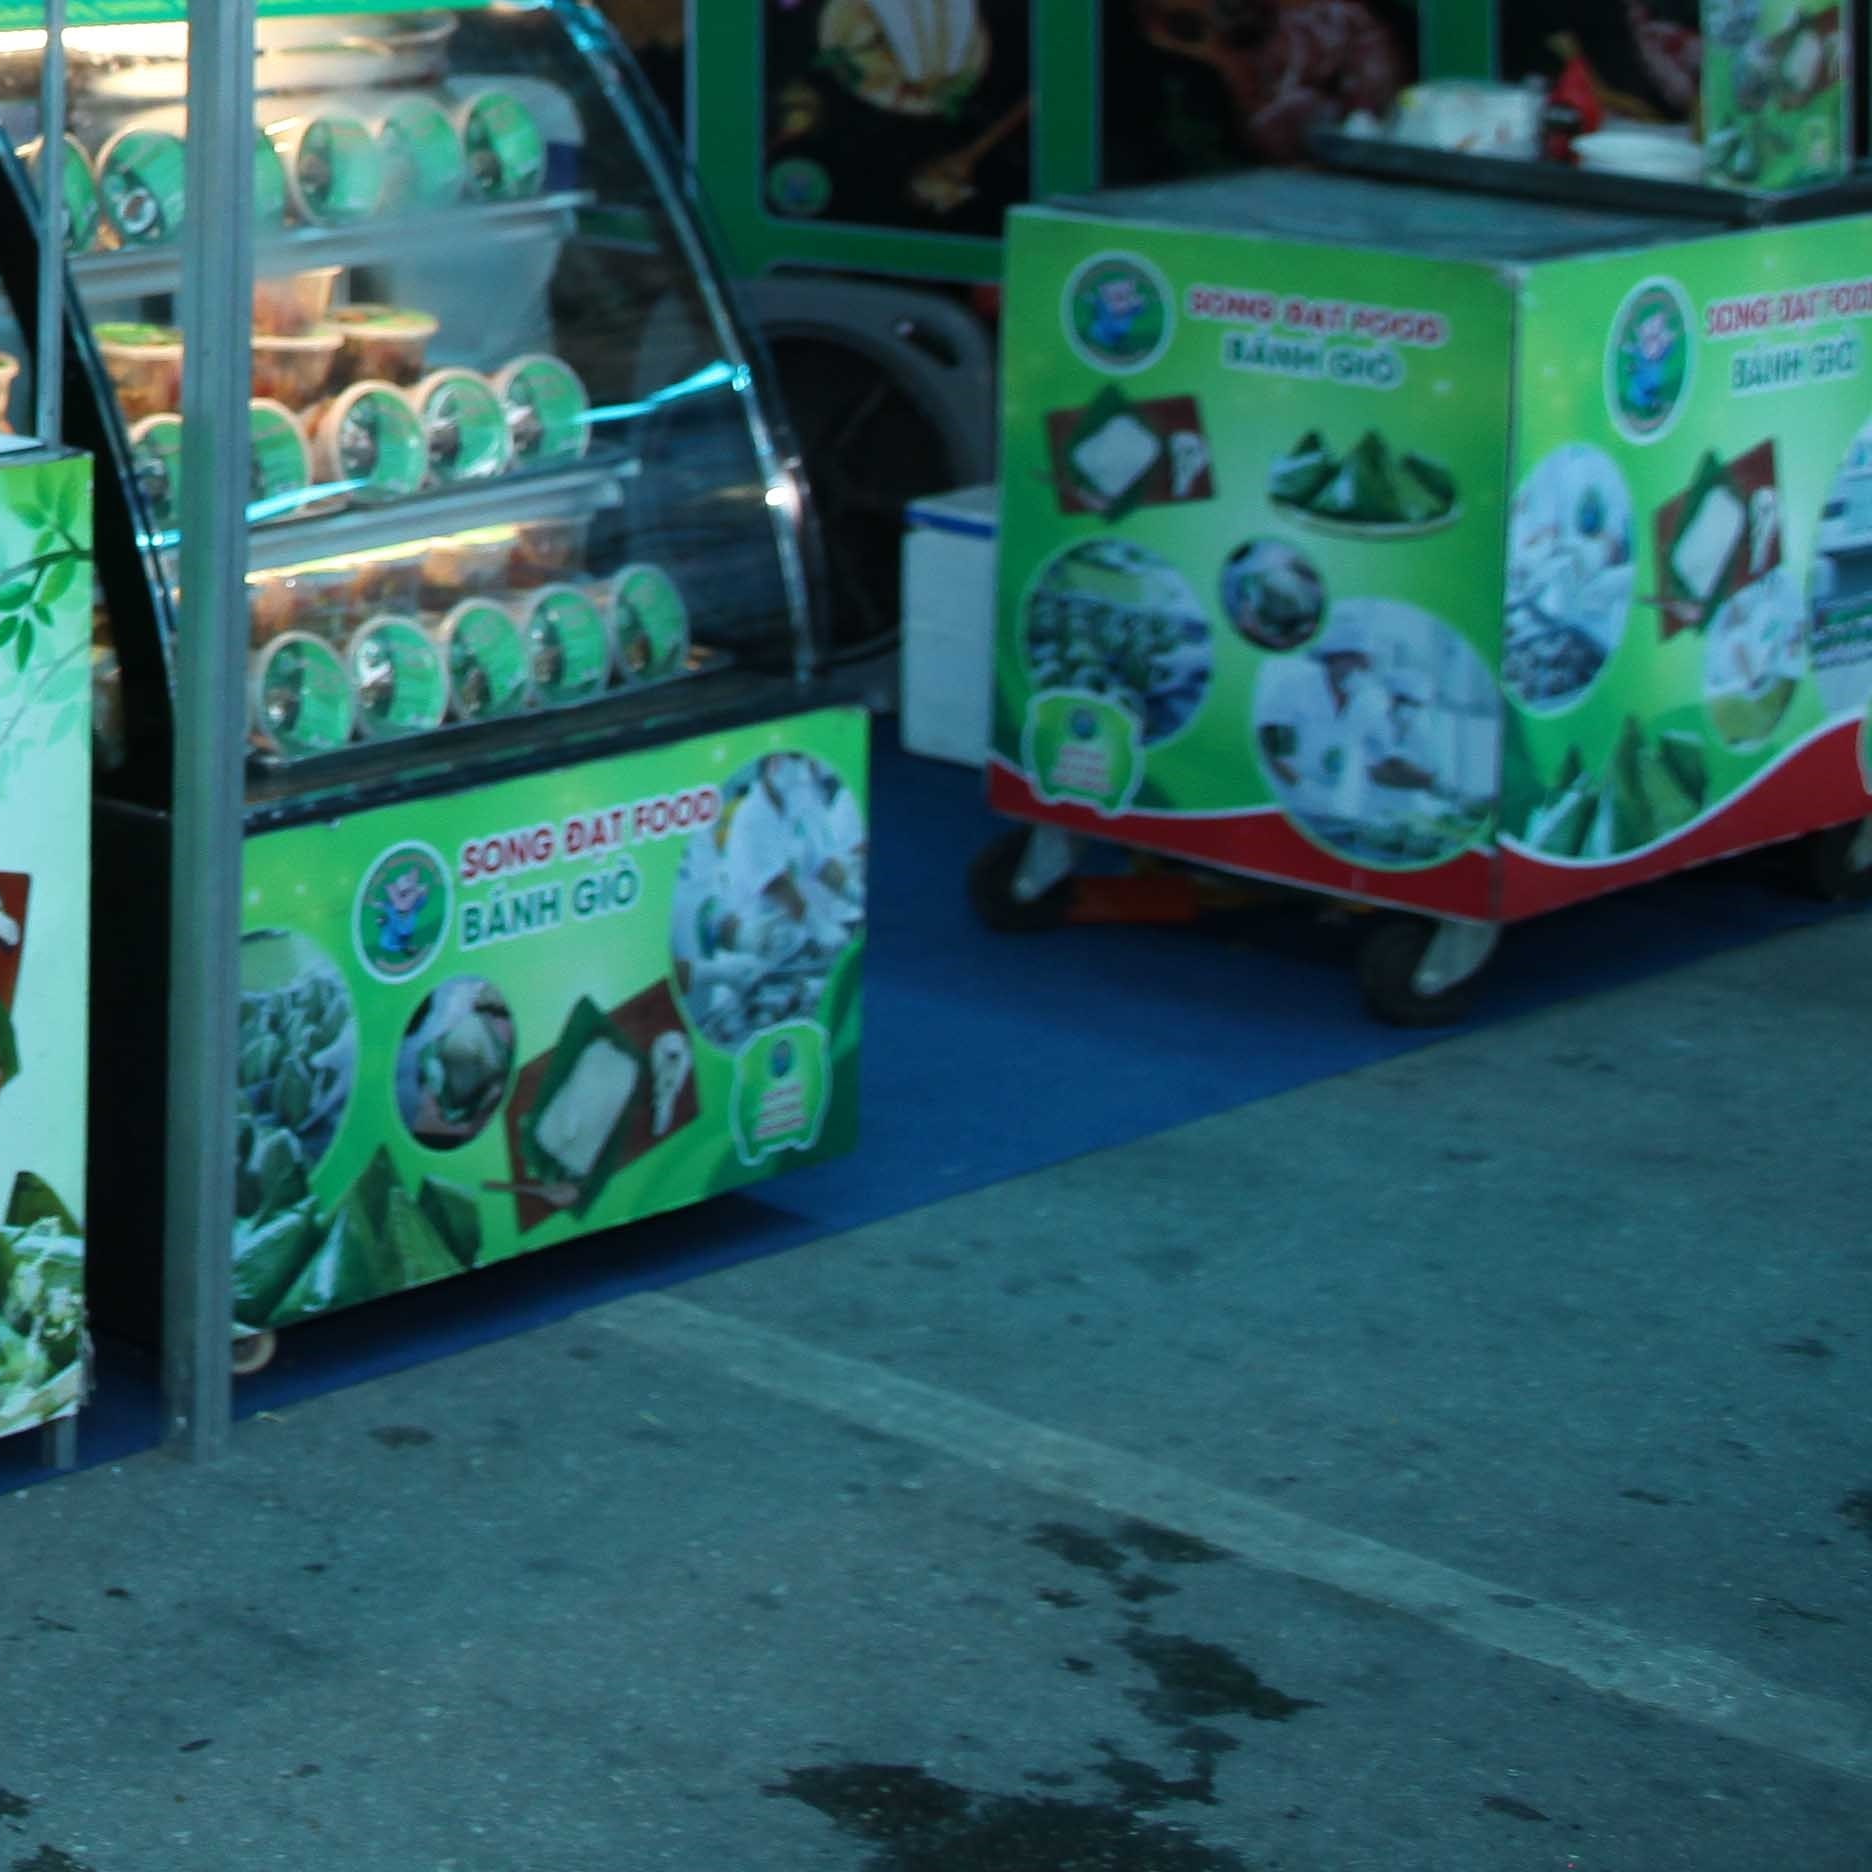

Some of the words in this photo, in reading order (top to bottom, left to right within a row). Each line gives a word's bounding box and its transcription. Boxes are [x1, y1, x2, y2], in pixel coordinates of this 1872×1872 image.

[461, 827, 554, 881] SONG
[563, 806, 626, 859] ĐẠT
[634, 786, 723, 836] FOOD
[461, 885, 562, 945] BÁNH
[571, 856, 641, 921] GIÒ
